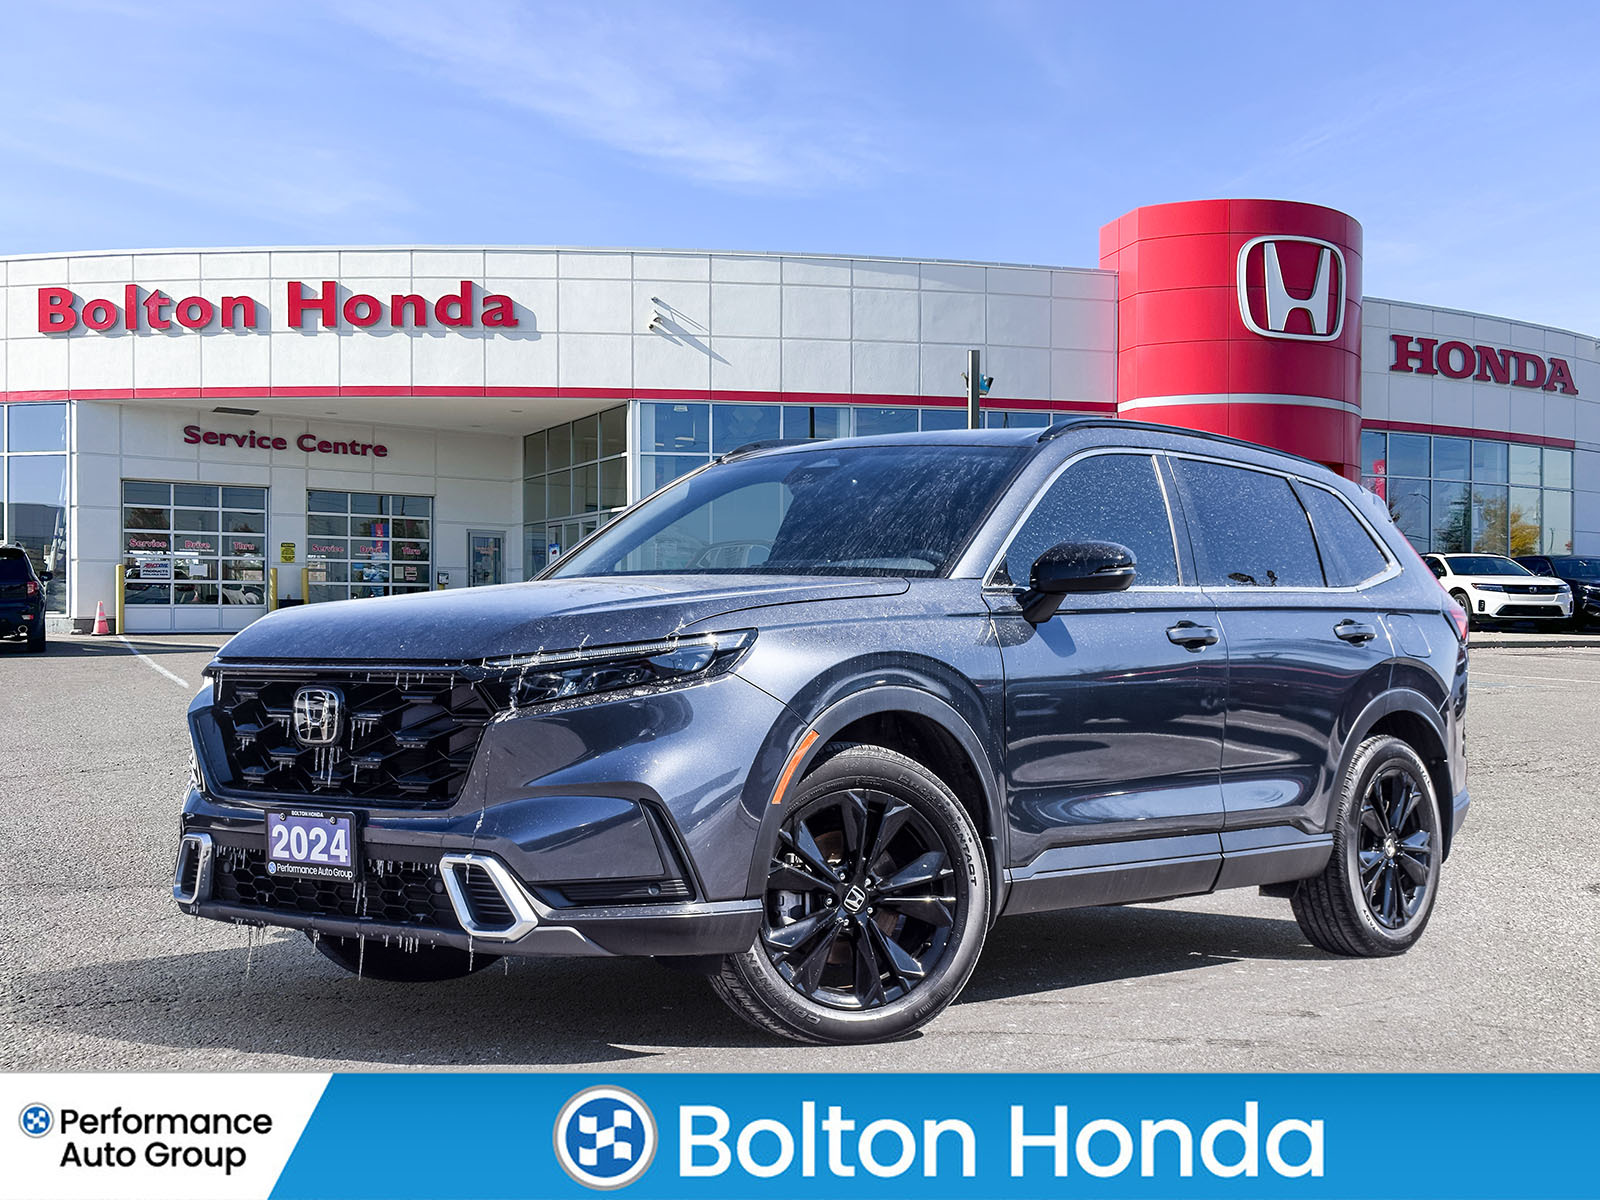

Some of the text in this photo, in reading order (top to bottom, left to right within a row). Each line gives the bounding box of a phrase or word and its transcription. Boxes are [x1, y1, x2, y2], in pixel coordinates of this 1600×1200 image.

[38, 280, 520, 333] Bolton Honda
[1389, 334, 1579, 395] HONDA
[183, 425, 388, 458] Service Centre
[129, 538, 255, 551] Service Drive Thru
[312, 543, 421, 556] Service Drive Thru
[271, 824, 348, 863] 2024
[277, 863, 353, 880] Performance Auto Group
